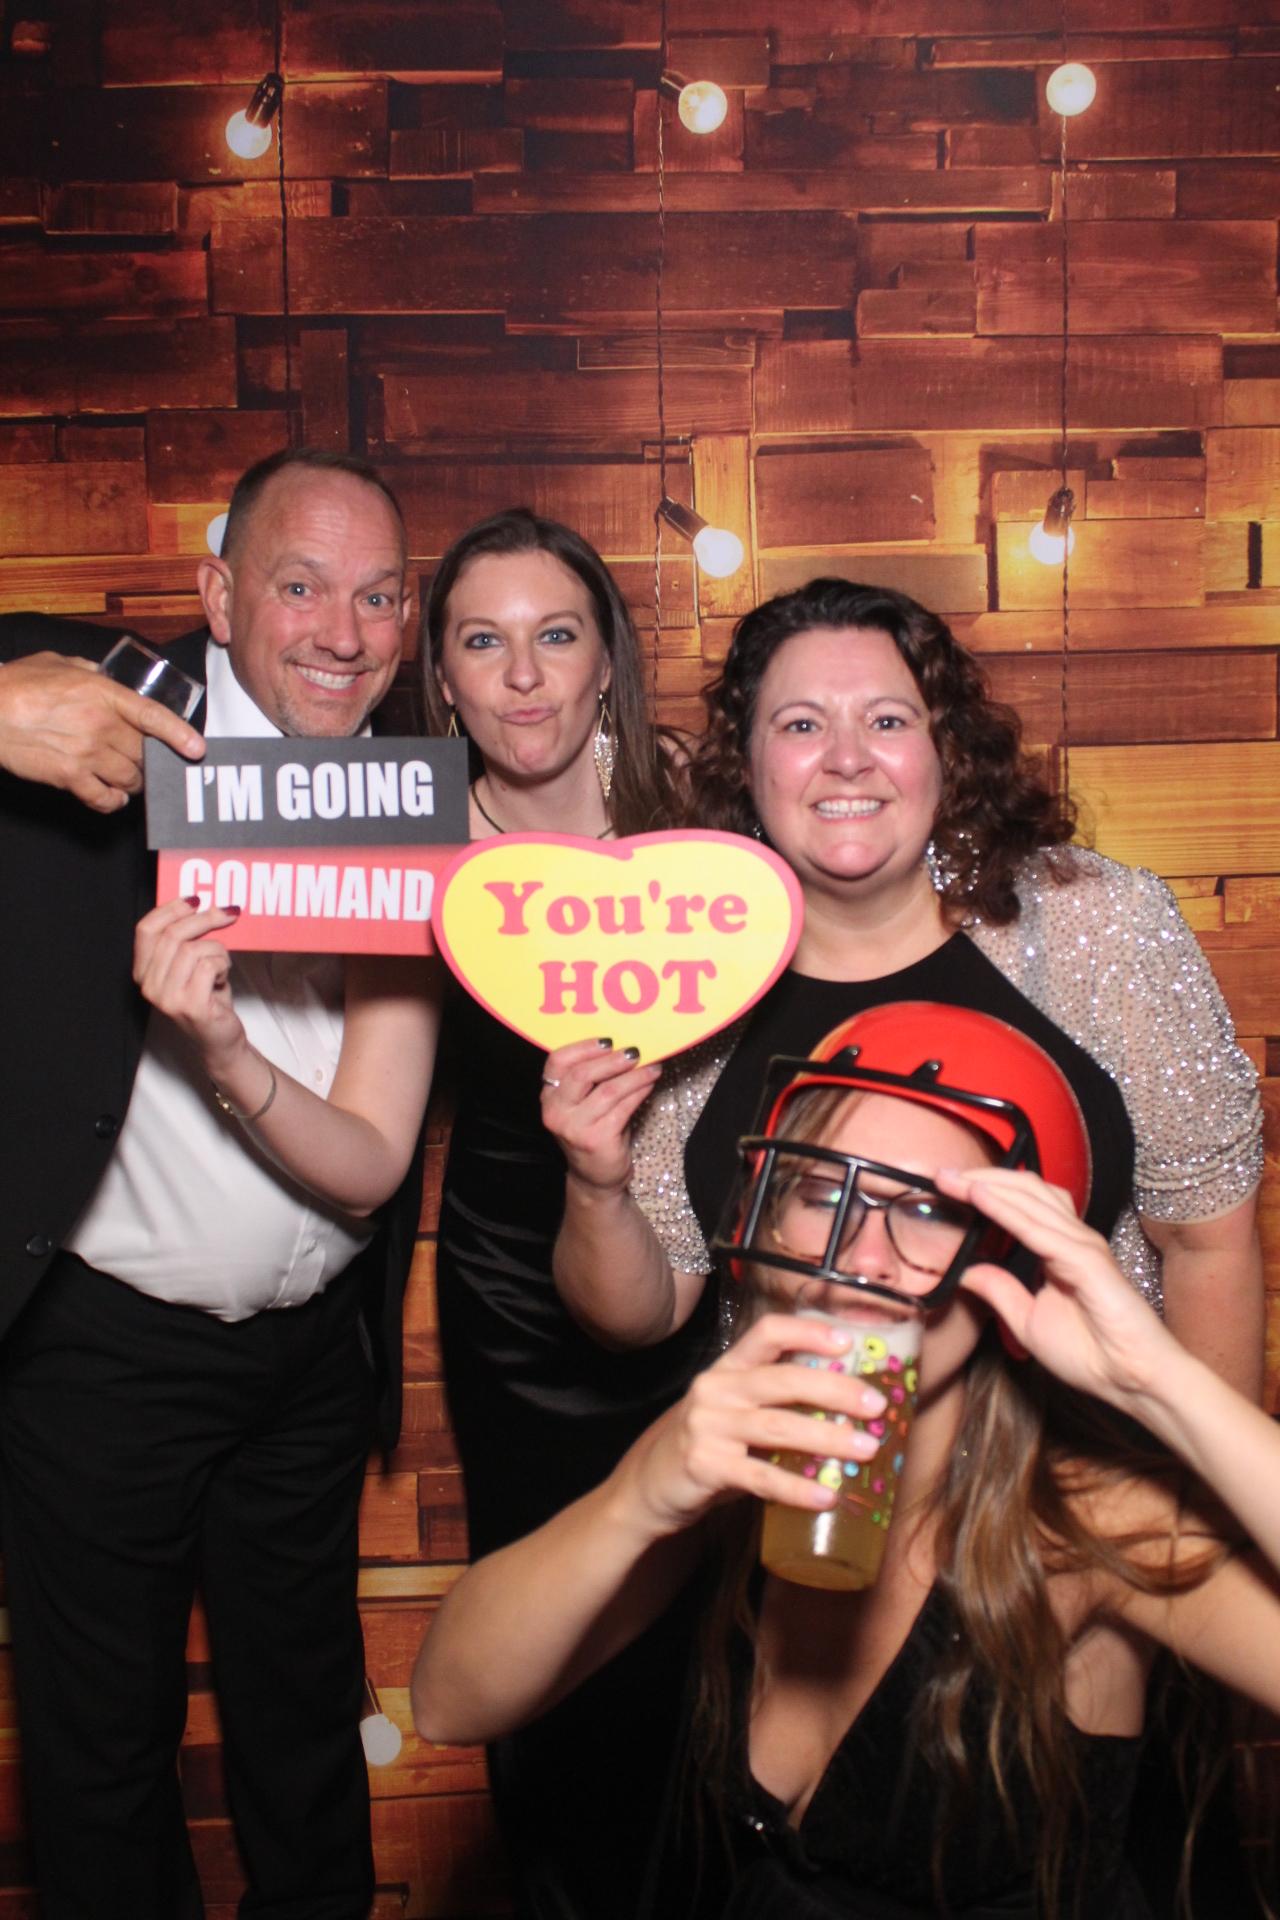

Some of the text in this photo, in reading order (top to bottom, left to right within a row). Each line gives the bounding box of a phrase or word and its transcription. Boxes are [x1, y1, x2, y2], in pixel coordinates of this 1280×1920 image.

[185, 760, 435, 823] I’M GOING
[179, 858, 435, 922] COMMAND
[483, 880, 748, 936] You're
[538, 959, 717, 1015] HOT
